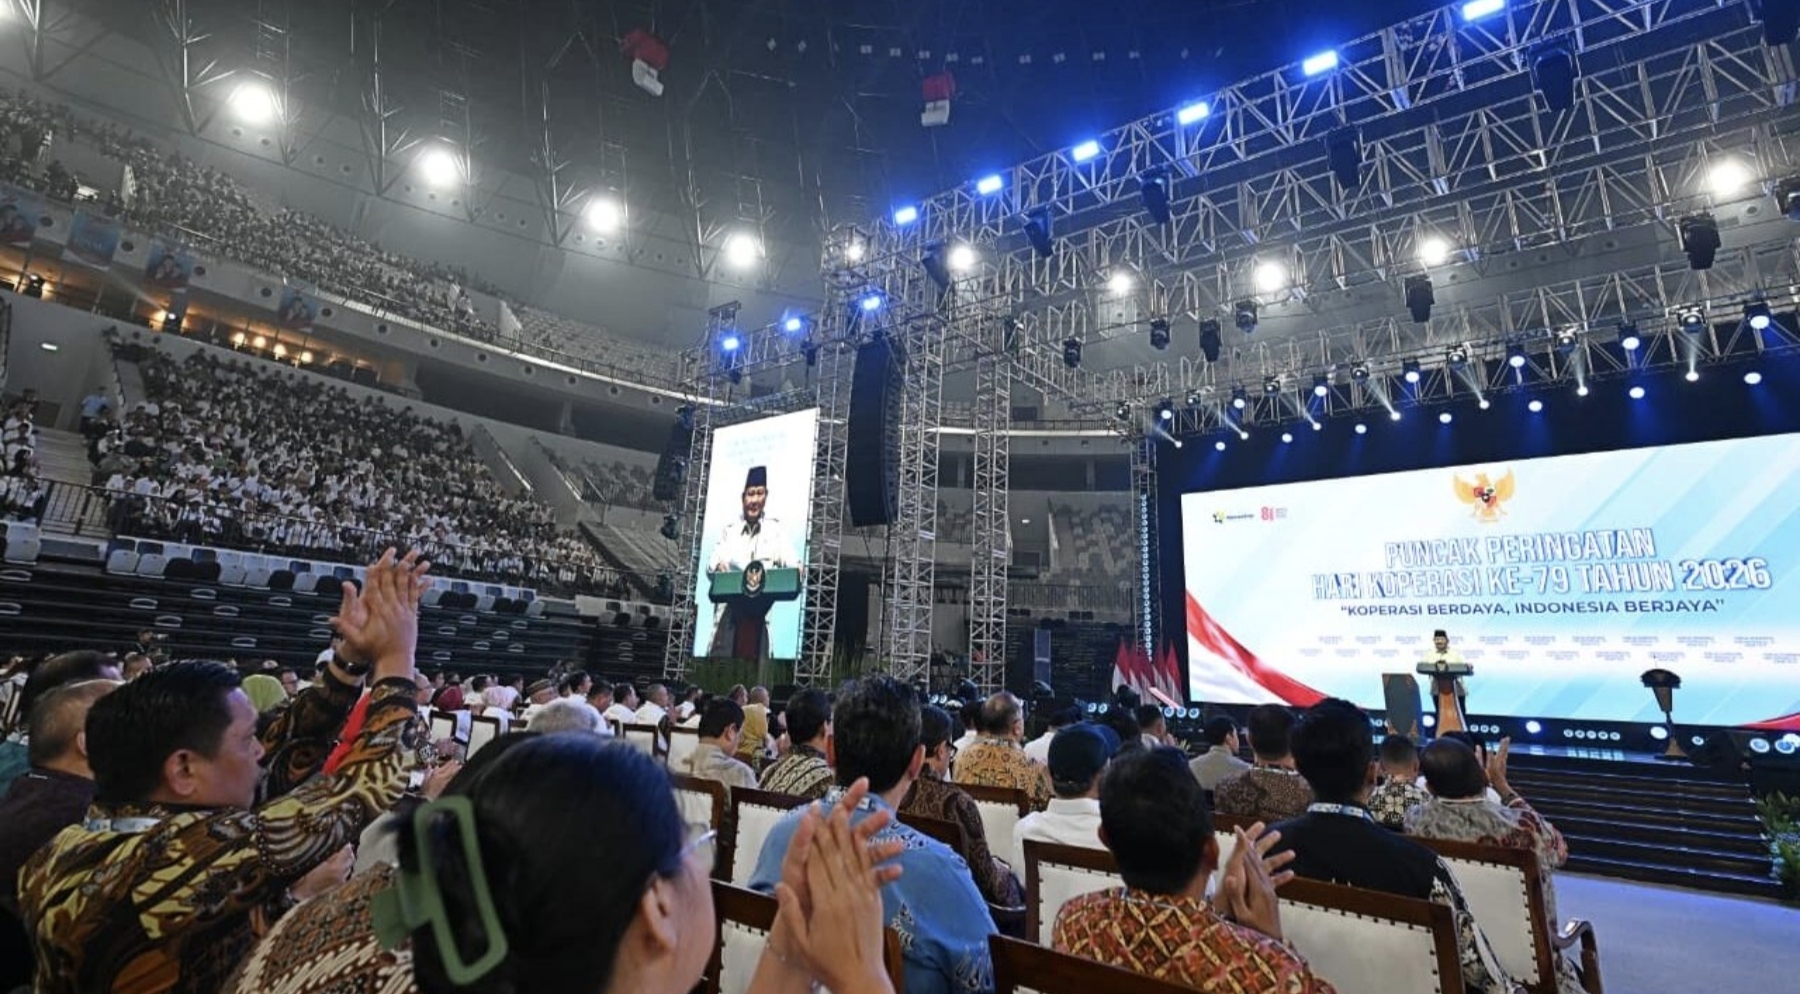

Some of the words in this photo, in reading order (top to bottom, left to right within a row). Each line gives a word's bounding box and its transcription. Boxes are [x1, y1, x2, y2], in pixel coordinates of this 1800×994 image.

[1385, 537, 1482, 568] PUNCAK
[1485, 528, 1656, 564] PERINGATAN
[1312, 572, 1361, 599] HARI
[1368, 567, 1482, 598] KOPERASI
[1486, 563, 1570, 596] KE-79
[1575, 560, 1675, 593] TAHUN
[1679, 557, 1772, 591] 2026
[1427, 602, 1511, 616] BERDAYA,
[1515, 600, 1619, 615] INDONESIA
